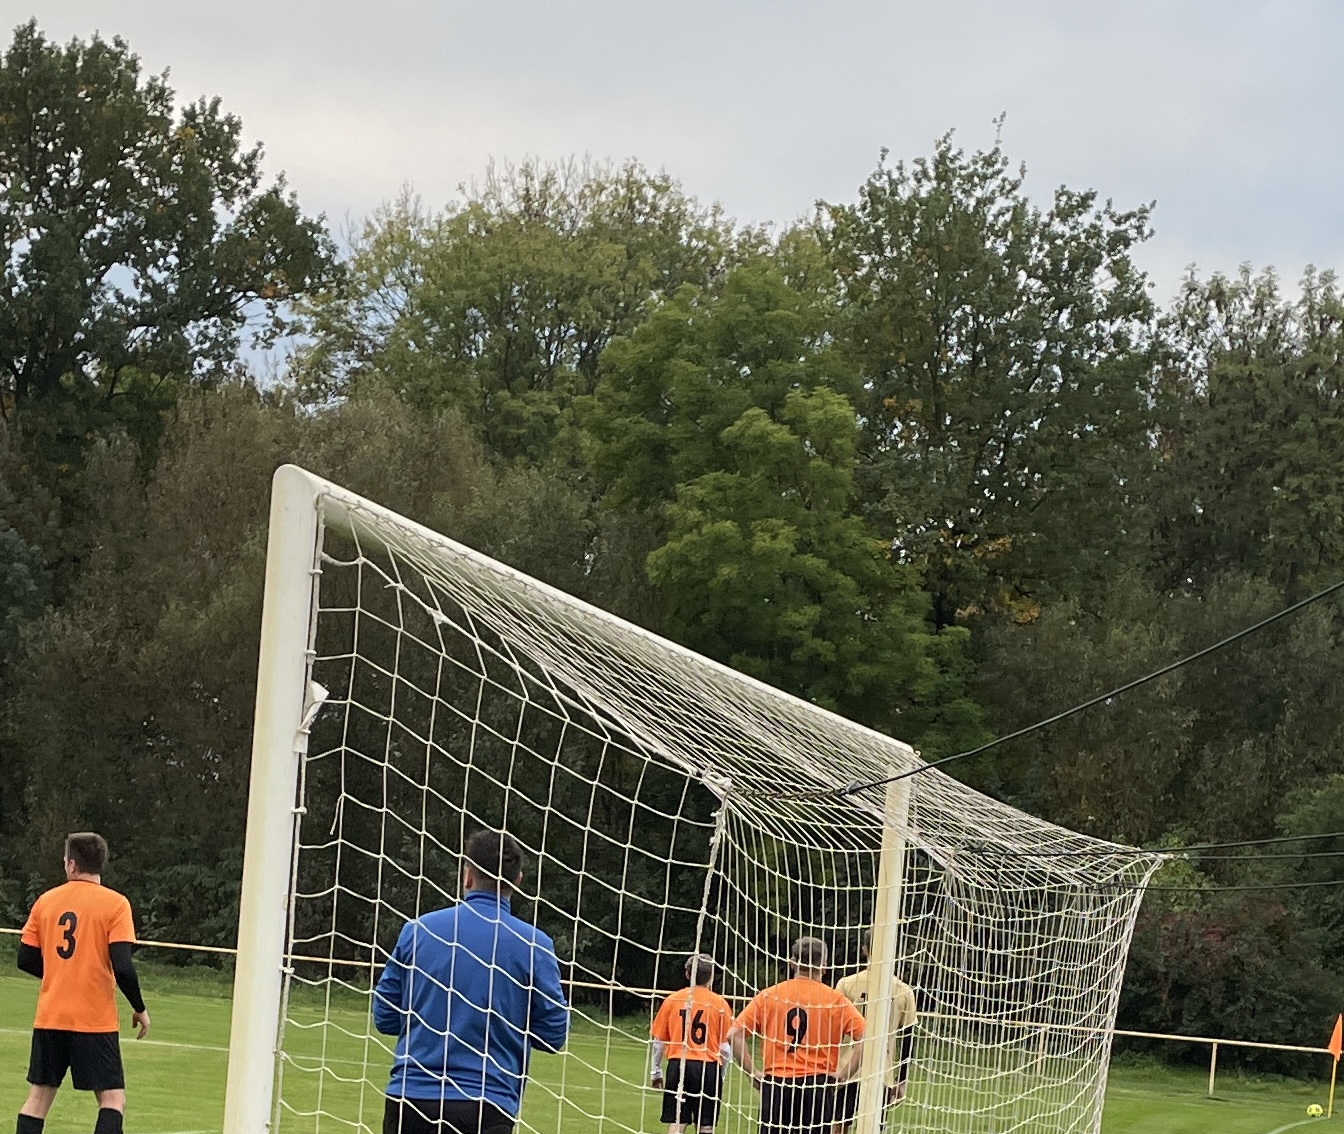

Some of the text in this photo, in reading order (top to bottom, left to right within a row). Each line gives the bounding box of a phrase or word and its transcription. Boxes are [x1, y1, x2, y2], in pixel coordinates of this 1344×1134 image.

[56, 911, 78, 960] 3
[679, 1008, 707, 1046] 16
[786, 1007, 807, 1053] 9
